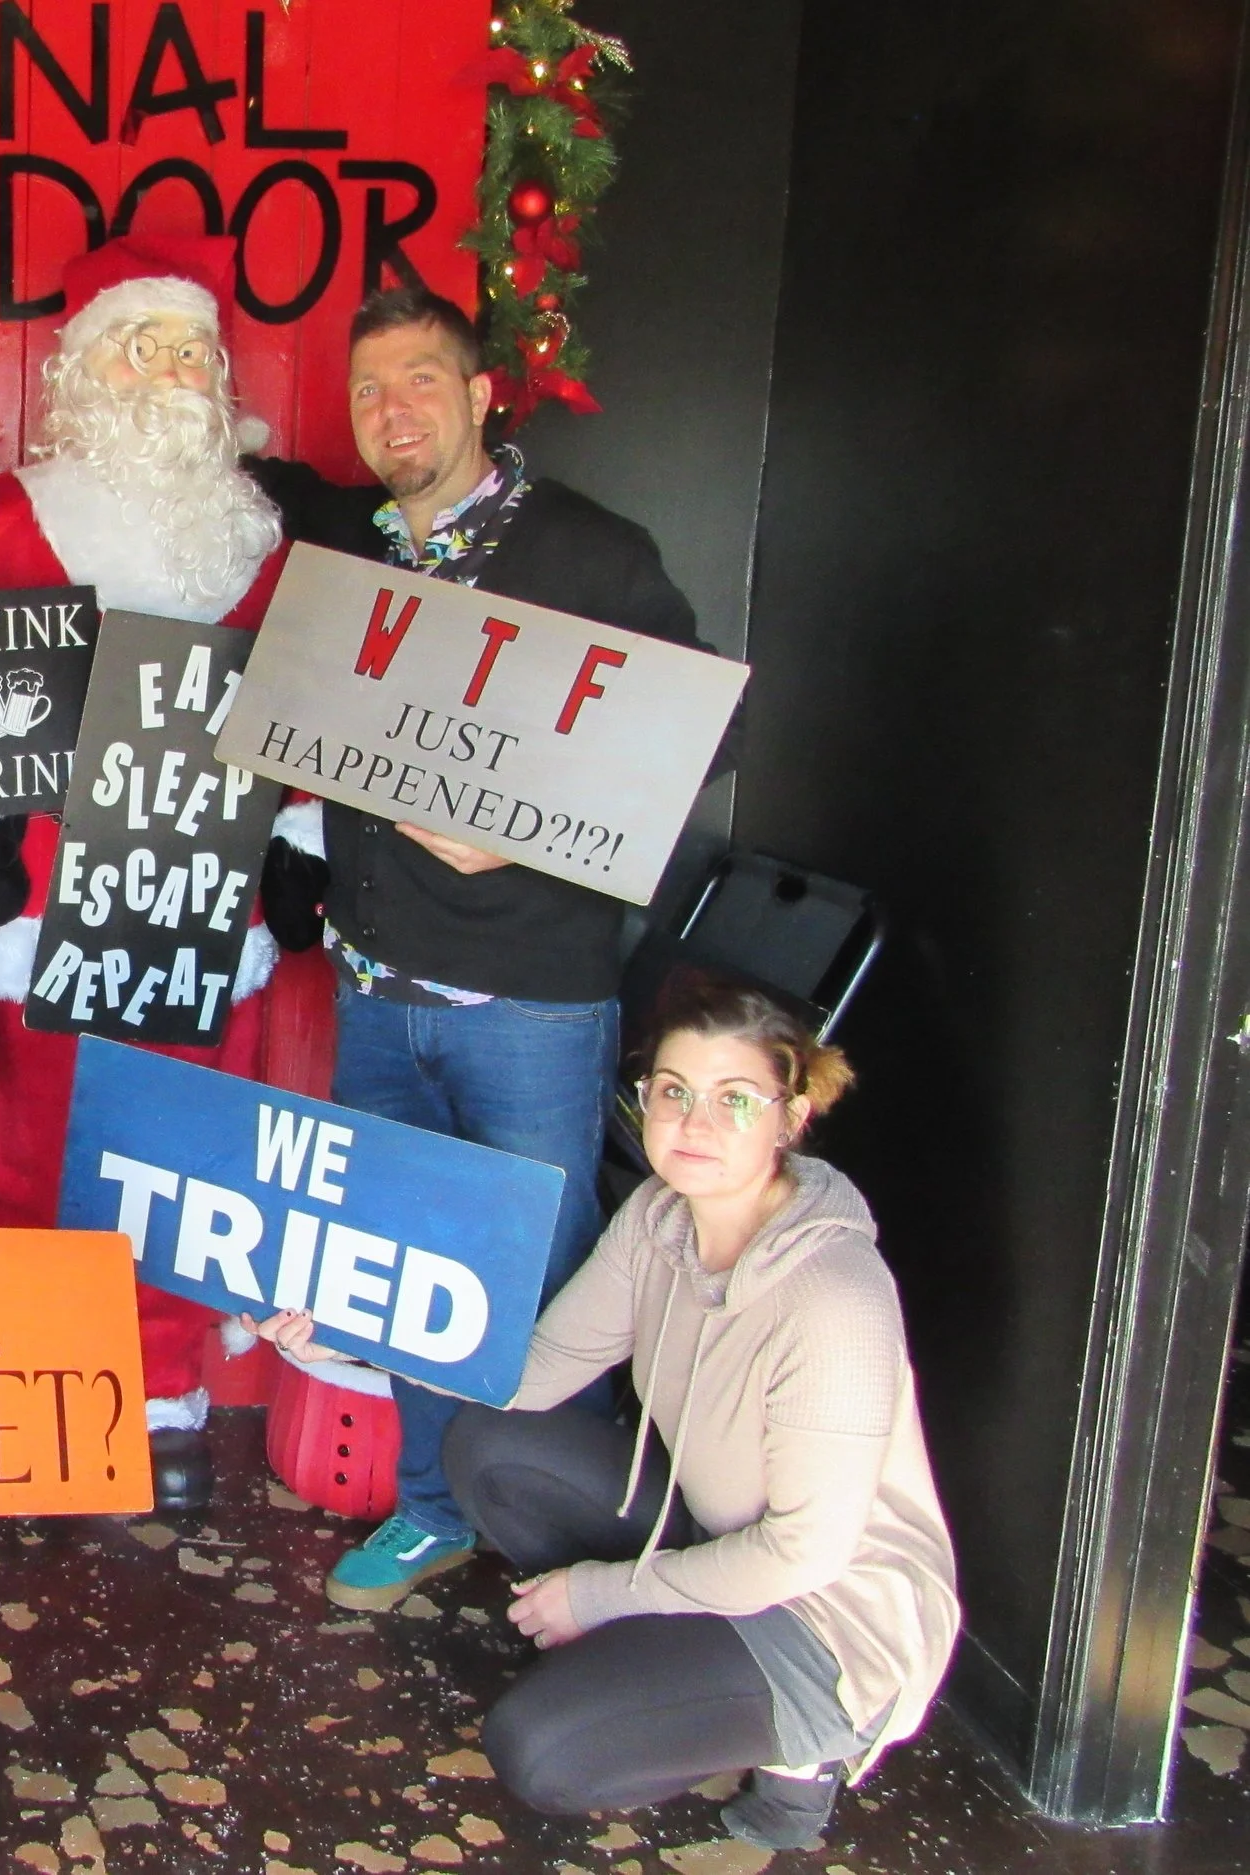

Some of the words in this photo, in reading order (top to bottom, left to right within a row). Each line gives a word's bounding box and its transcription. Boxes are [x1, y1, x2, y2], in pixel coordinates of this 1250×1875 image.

[139, 645, 243, 736] EAT
[385, 702, 519, 772] JUST
[92, 741, 253, 837] SLEEP
[256, 721, 625, 872] HAPPENED?!?!
[58, 842, 248, 932] ESCAPE
[32, 940, 228, 1031] REPEAT
[256, 1103, 353, 1206] WE
[99, 1150, 489, 1363] TRIED
